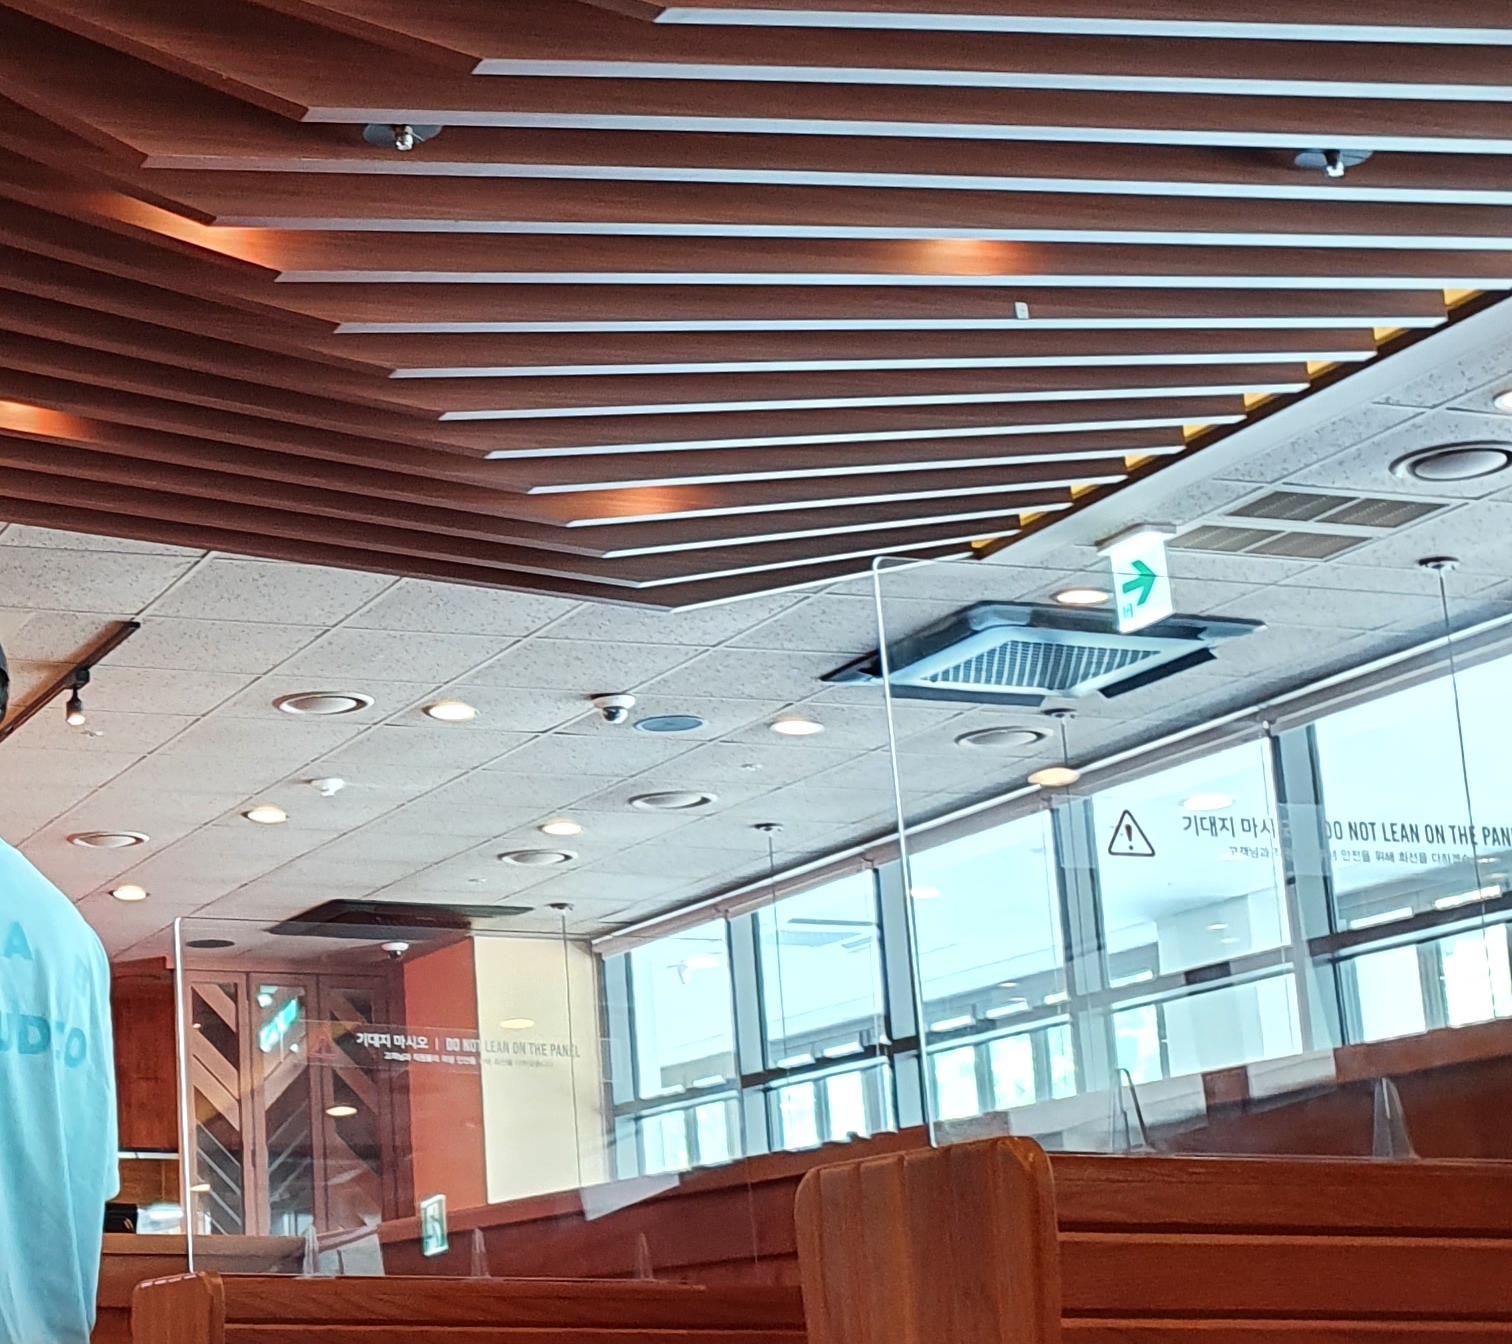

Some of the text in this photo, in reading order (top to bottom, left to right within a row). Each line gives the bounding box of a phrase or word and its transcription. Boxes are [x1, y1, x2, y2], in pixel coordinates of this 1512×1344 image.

[1182, 815, 1236, 838] 기대지
[1348, 821, 1377, 842] NOT
[1381, 822, 1420, 843] LEAN
[1424, 824, 1446, 845] ON
[1448, 825, 1478, 845] THE
[1481, 826, 1512, 847] PAN
[393, 1034, 430, 1050] 마시오
[484, 1039, 511, 1054] LEAN
[512, 1041, 527, 1056] ON
[529, 1042, 548, 1057] THE
